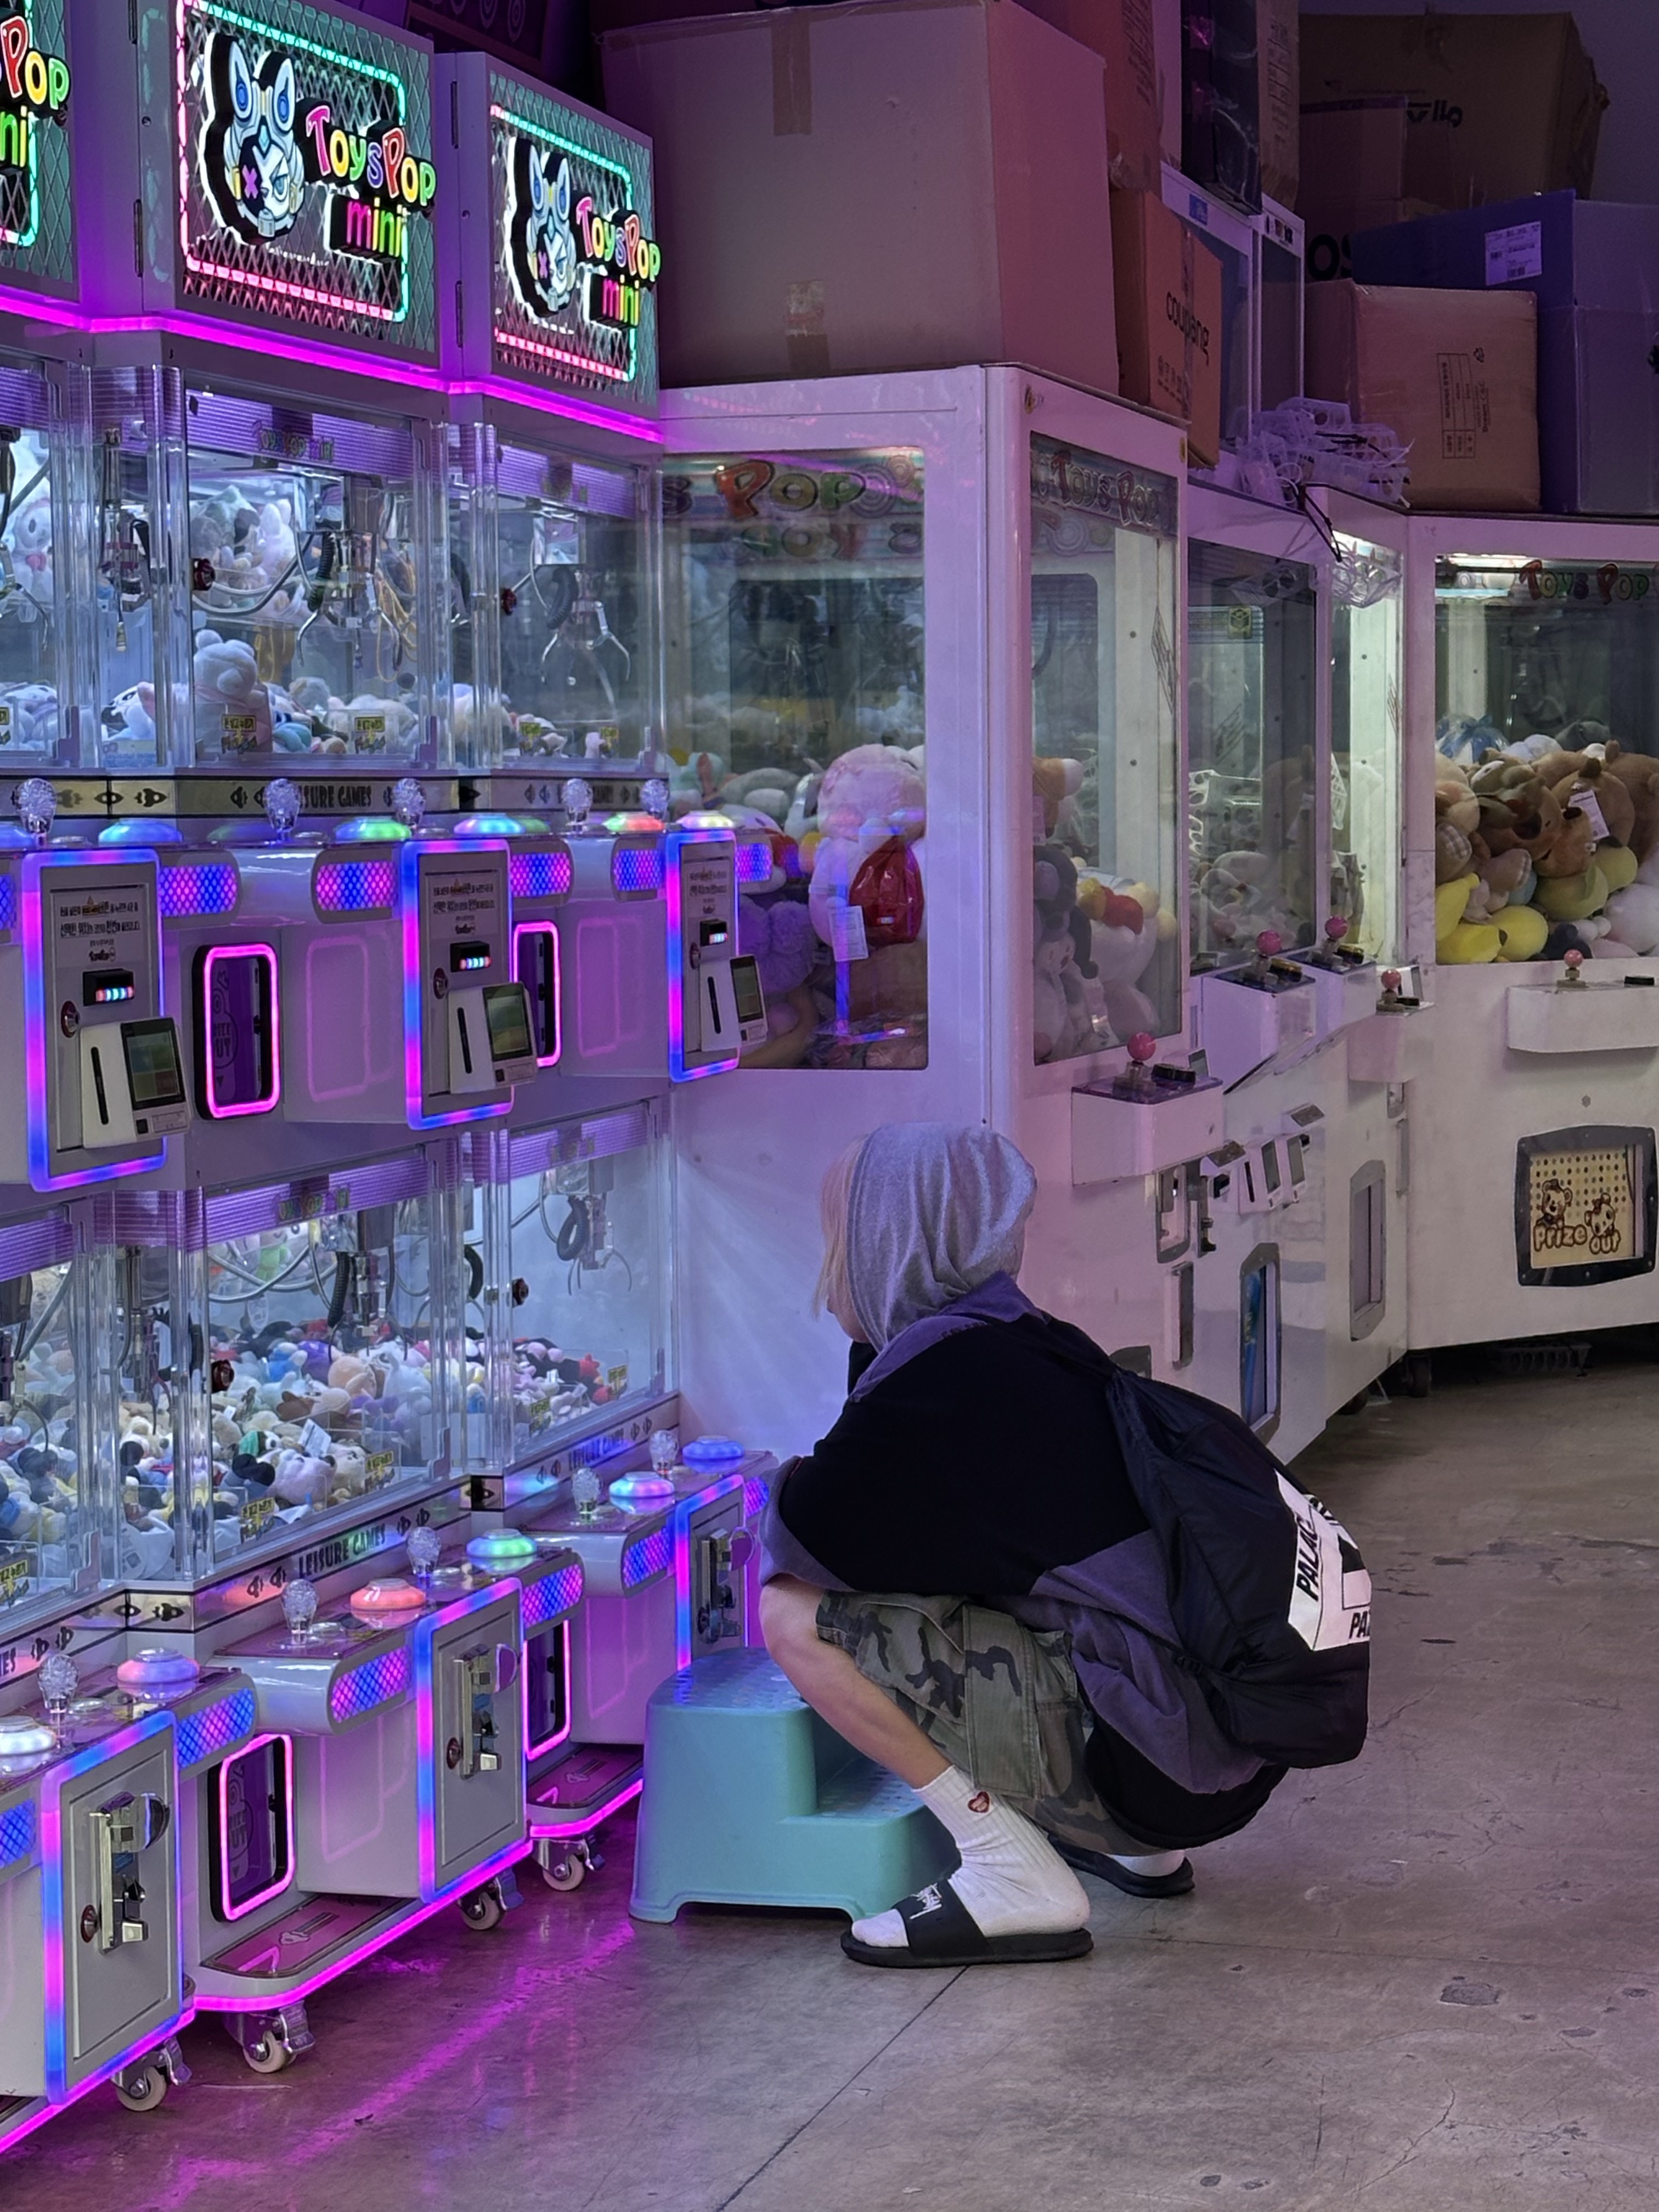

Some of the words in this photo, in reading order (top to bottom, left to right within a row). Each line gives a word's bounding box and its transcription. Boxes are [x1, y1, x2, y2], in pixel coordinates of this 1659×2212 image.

[346, 197, 403, 258] mini
[601, 274, 641, 327] mini
[1166, 291, 1209, 366] coupang
[337, 785, 372, 808] GAMES
[298, 1538, 349, 1579] LEISURE
[353, 1523, 386, 1556] GAMES
